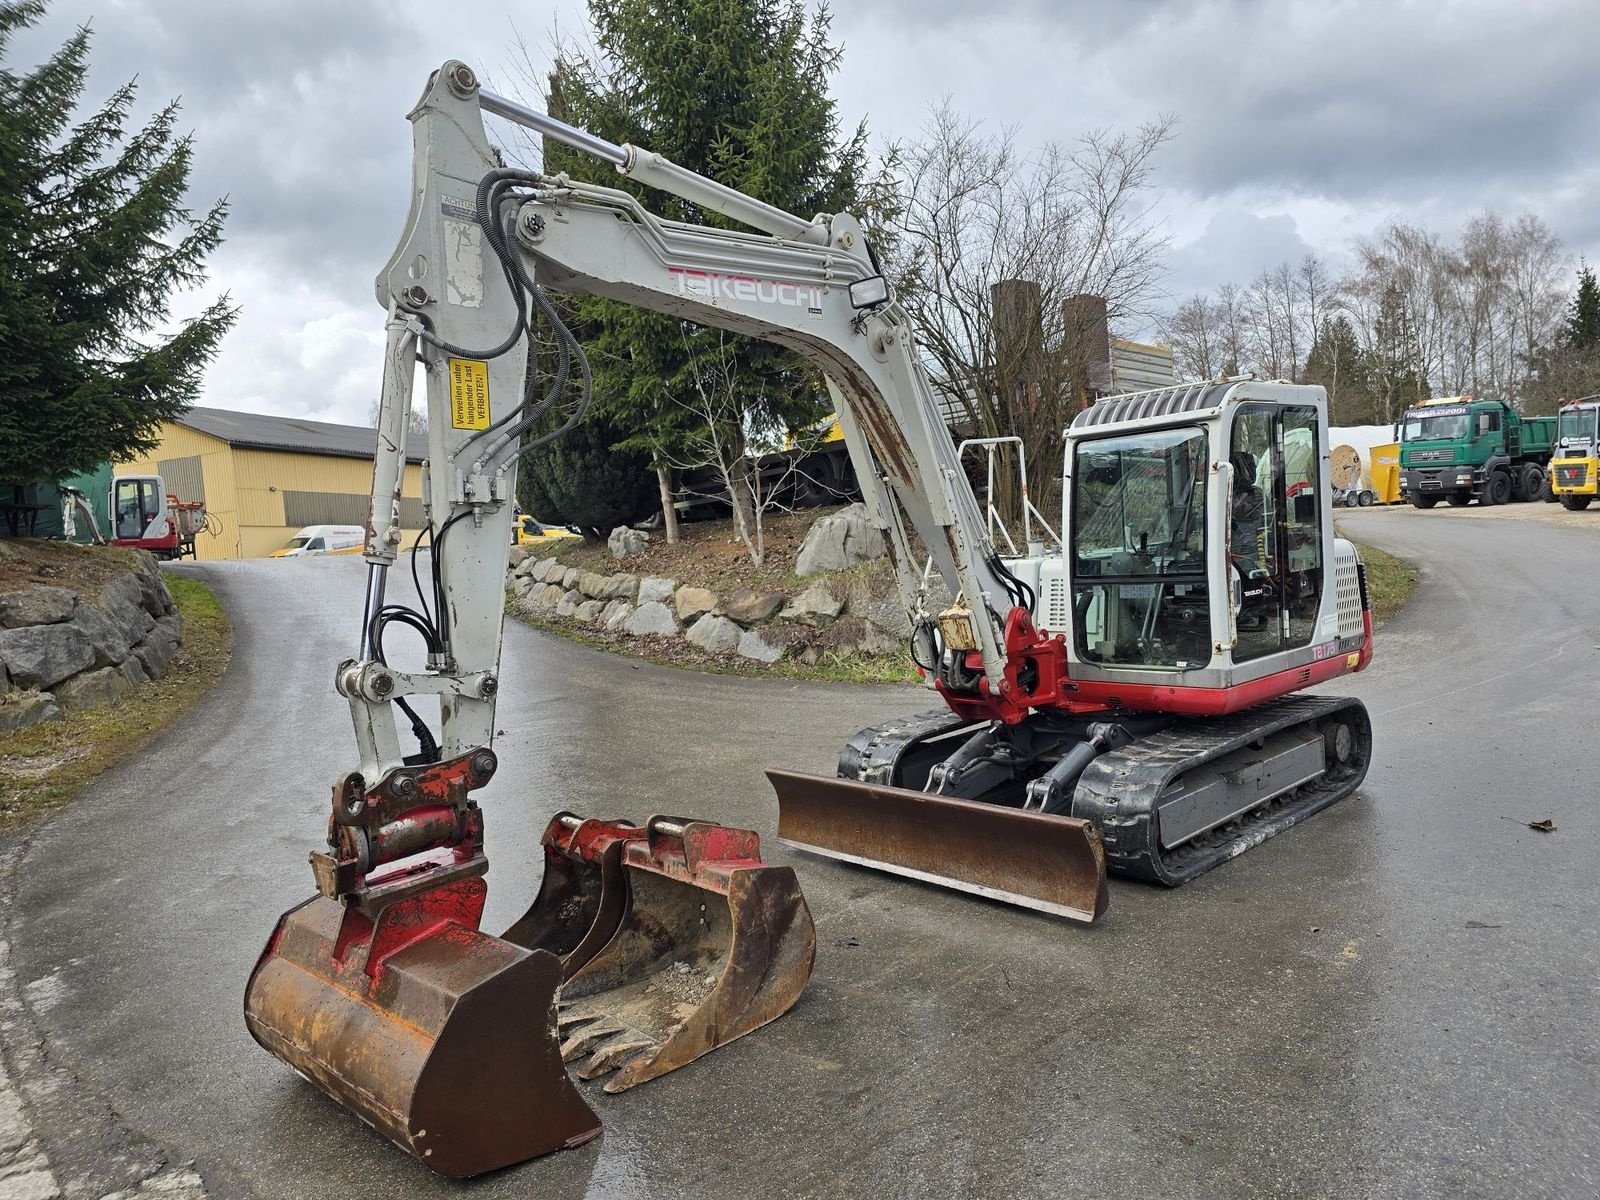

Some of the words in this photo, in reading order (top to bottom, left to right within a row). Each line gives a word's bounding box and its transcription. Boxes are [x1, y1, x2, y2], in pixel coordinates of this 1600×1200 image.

[444, 196, 476, 210] ACHTUN
[668, 267, 822, 309] TAKEUCHI
[453, 363, 462, 384] unter
[464, 365, 473, 383] Last
[454, 386, 464, 425] Verweilen
[465, 384, 475, 425] hängender
[475, 373, 486, 419] VERBOTEN!
[1312, 641, 1336, 660] TB175
